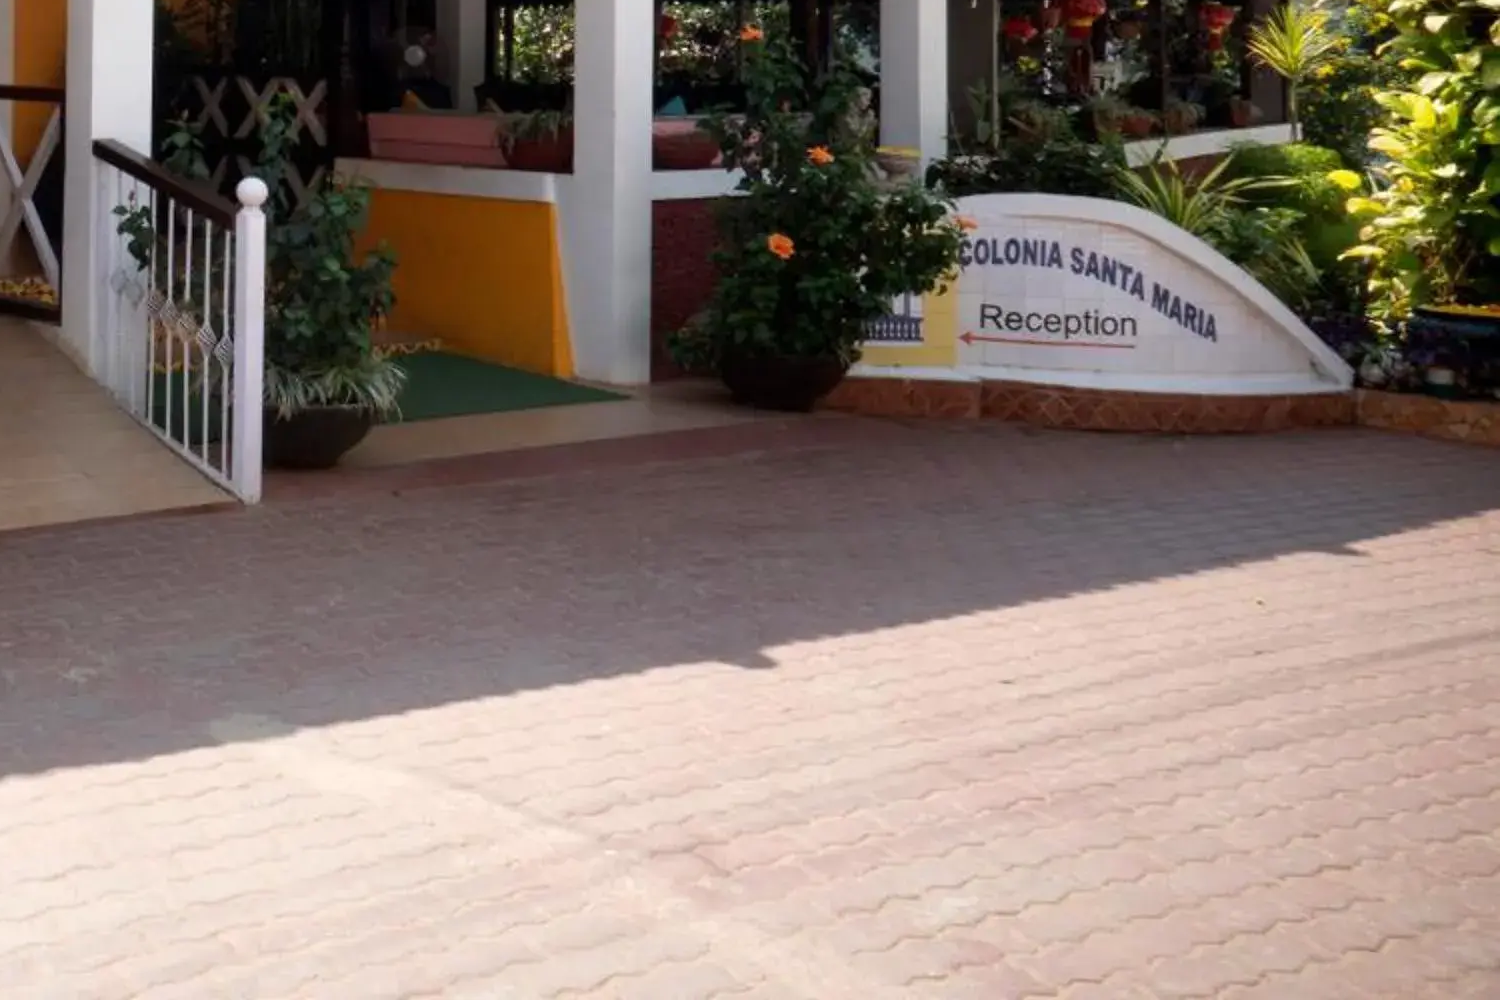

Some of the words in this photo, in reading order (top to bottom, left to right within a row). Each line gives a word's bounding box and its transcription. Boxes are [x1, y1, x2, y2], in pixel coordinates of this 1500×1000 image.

[960, 238, 1064, 269] COLONIA
[1070, 247, 1145, 301] SANTA
[1151, 281, 1217, 343] MARIA
[980, 303, 1137, 339] Reception
